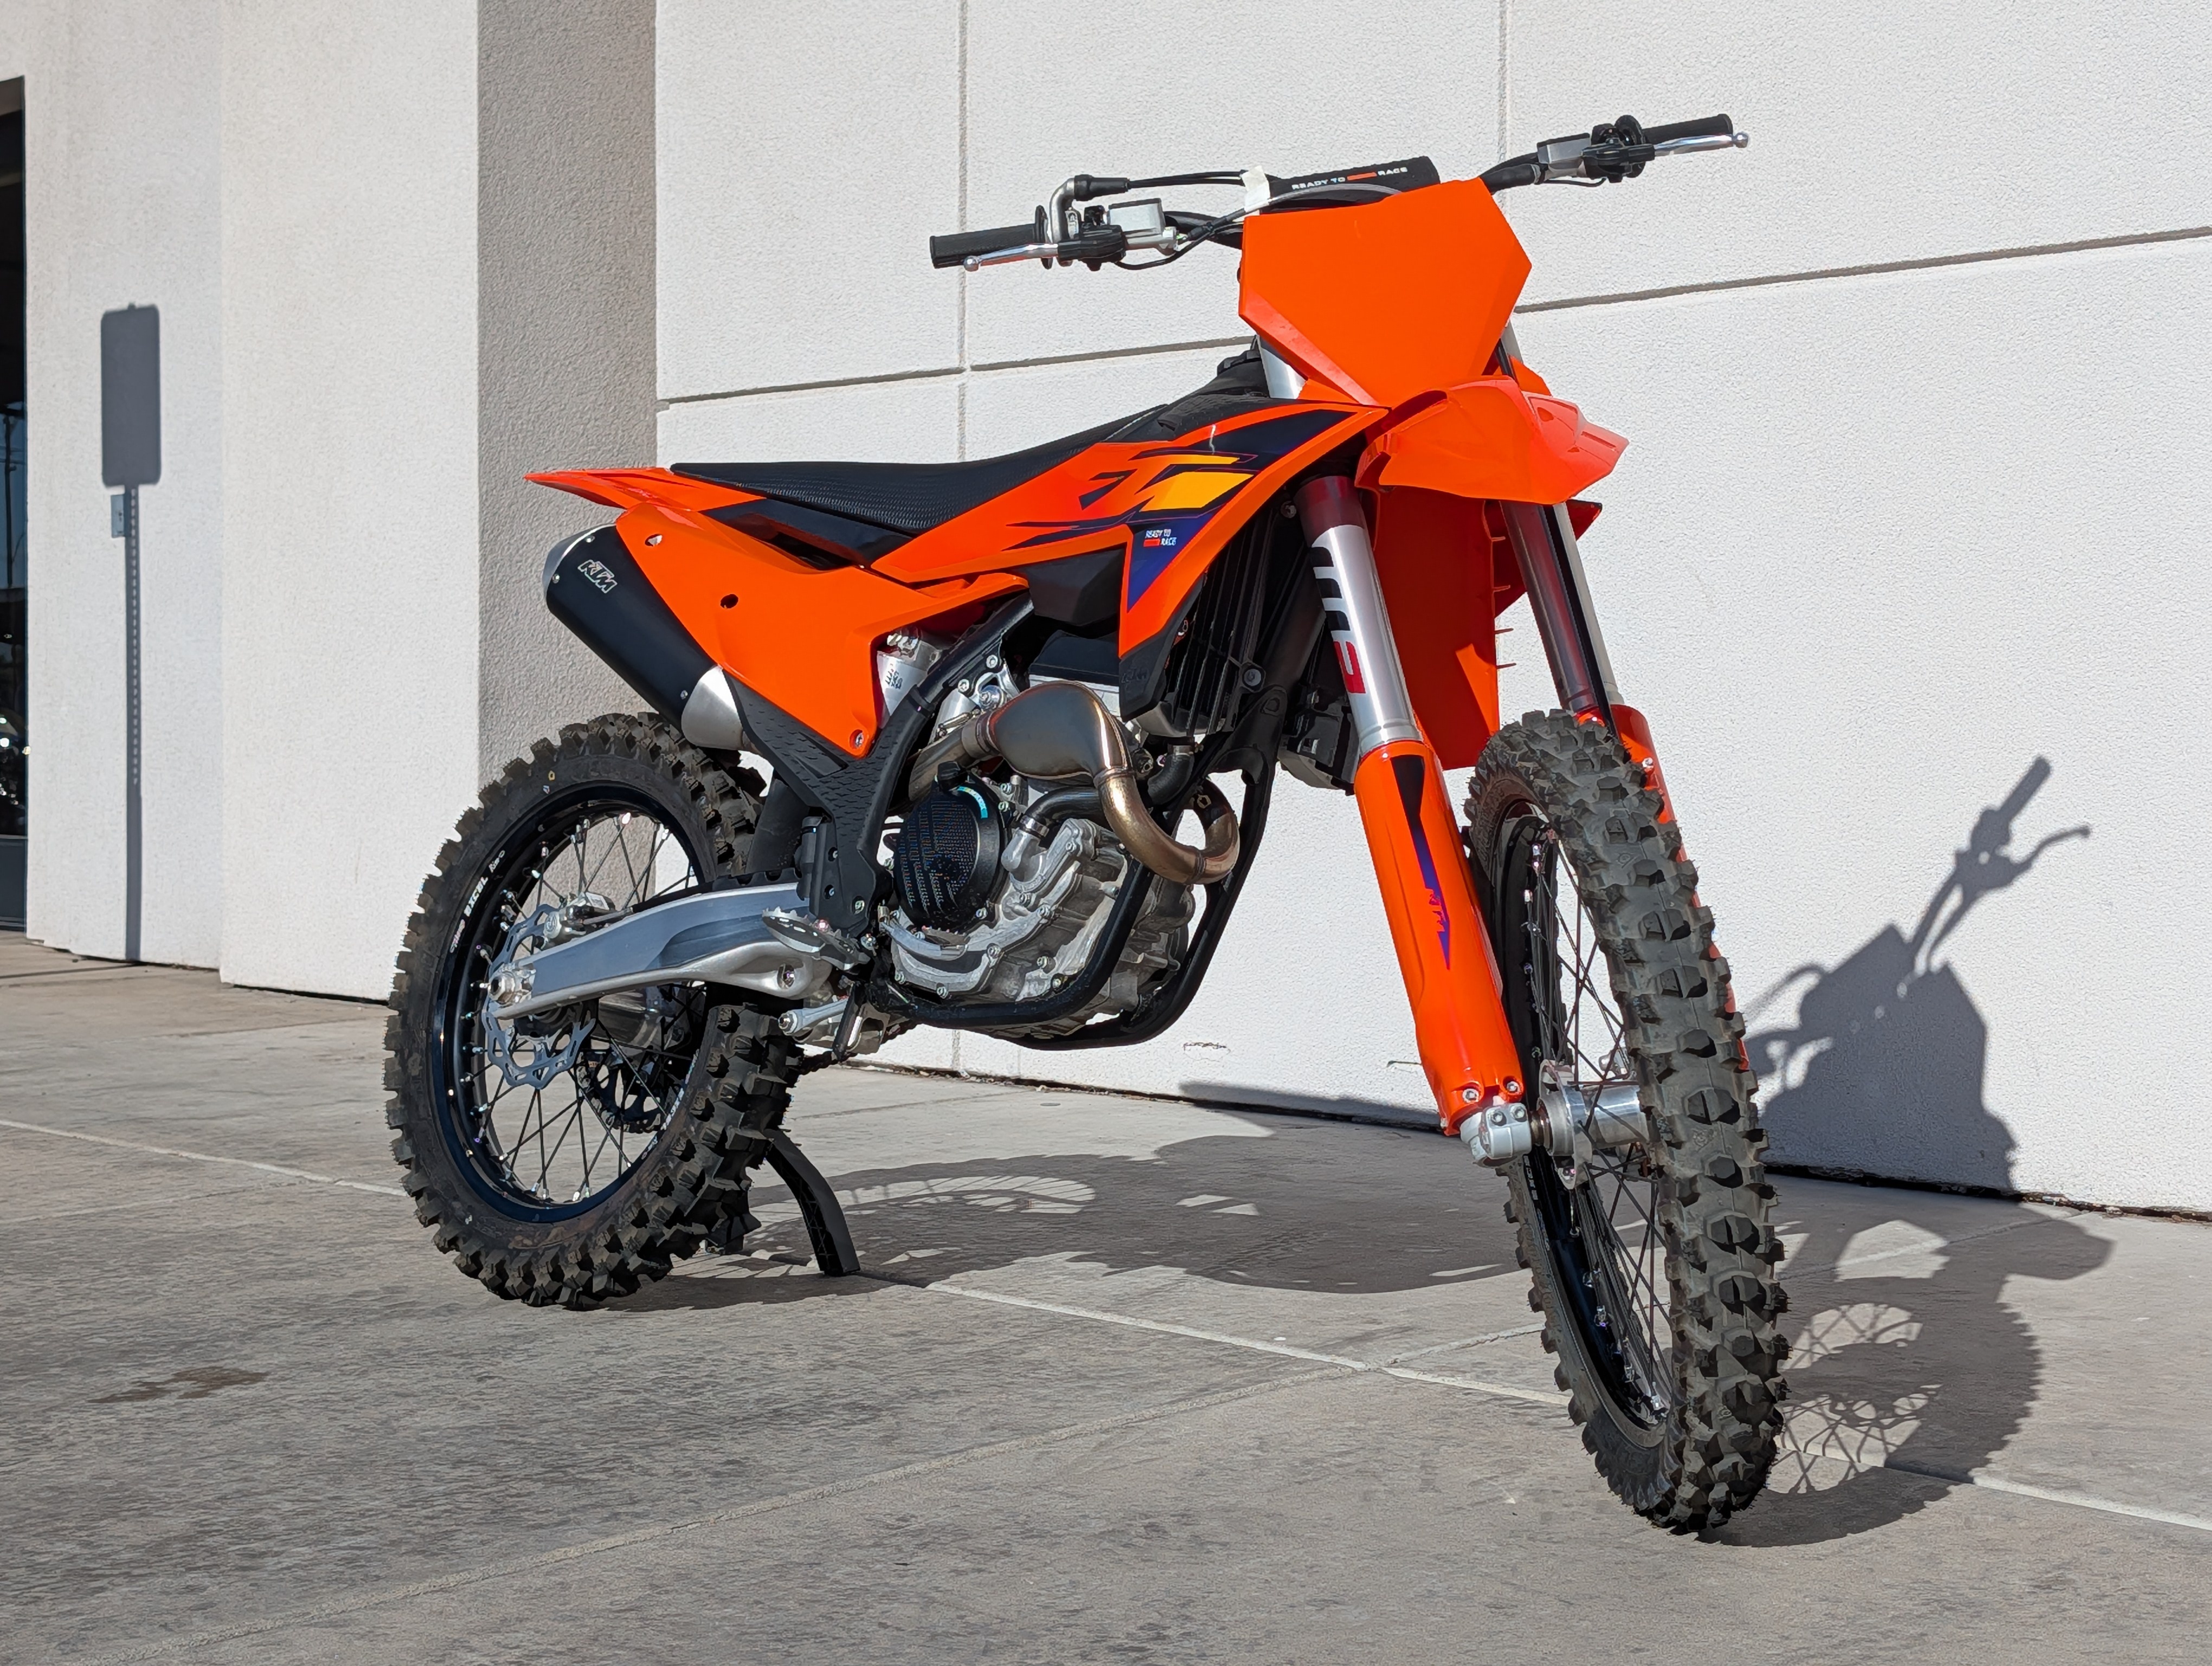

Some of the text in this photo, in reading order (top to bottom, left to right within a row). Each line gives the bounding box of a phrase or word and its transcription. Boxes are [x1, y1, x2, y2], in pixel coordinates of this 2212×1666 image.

[1291, 179, 1328, 190] READY
[1377, 166, 1408, 176] RACE
[577, 559, 618, 593] KTM
